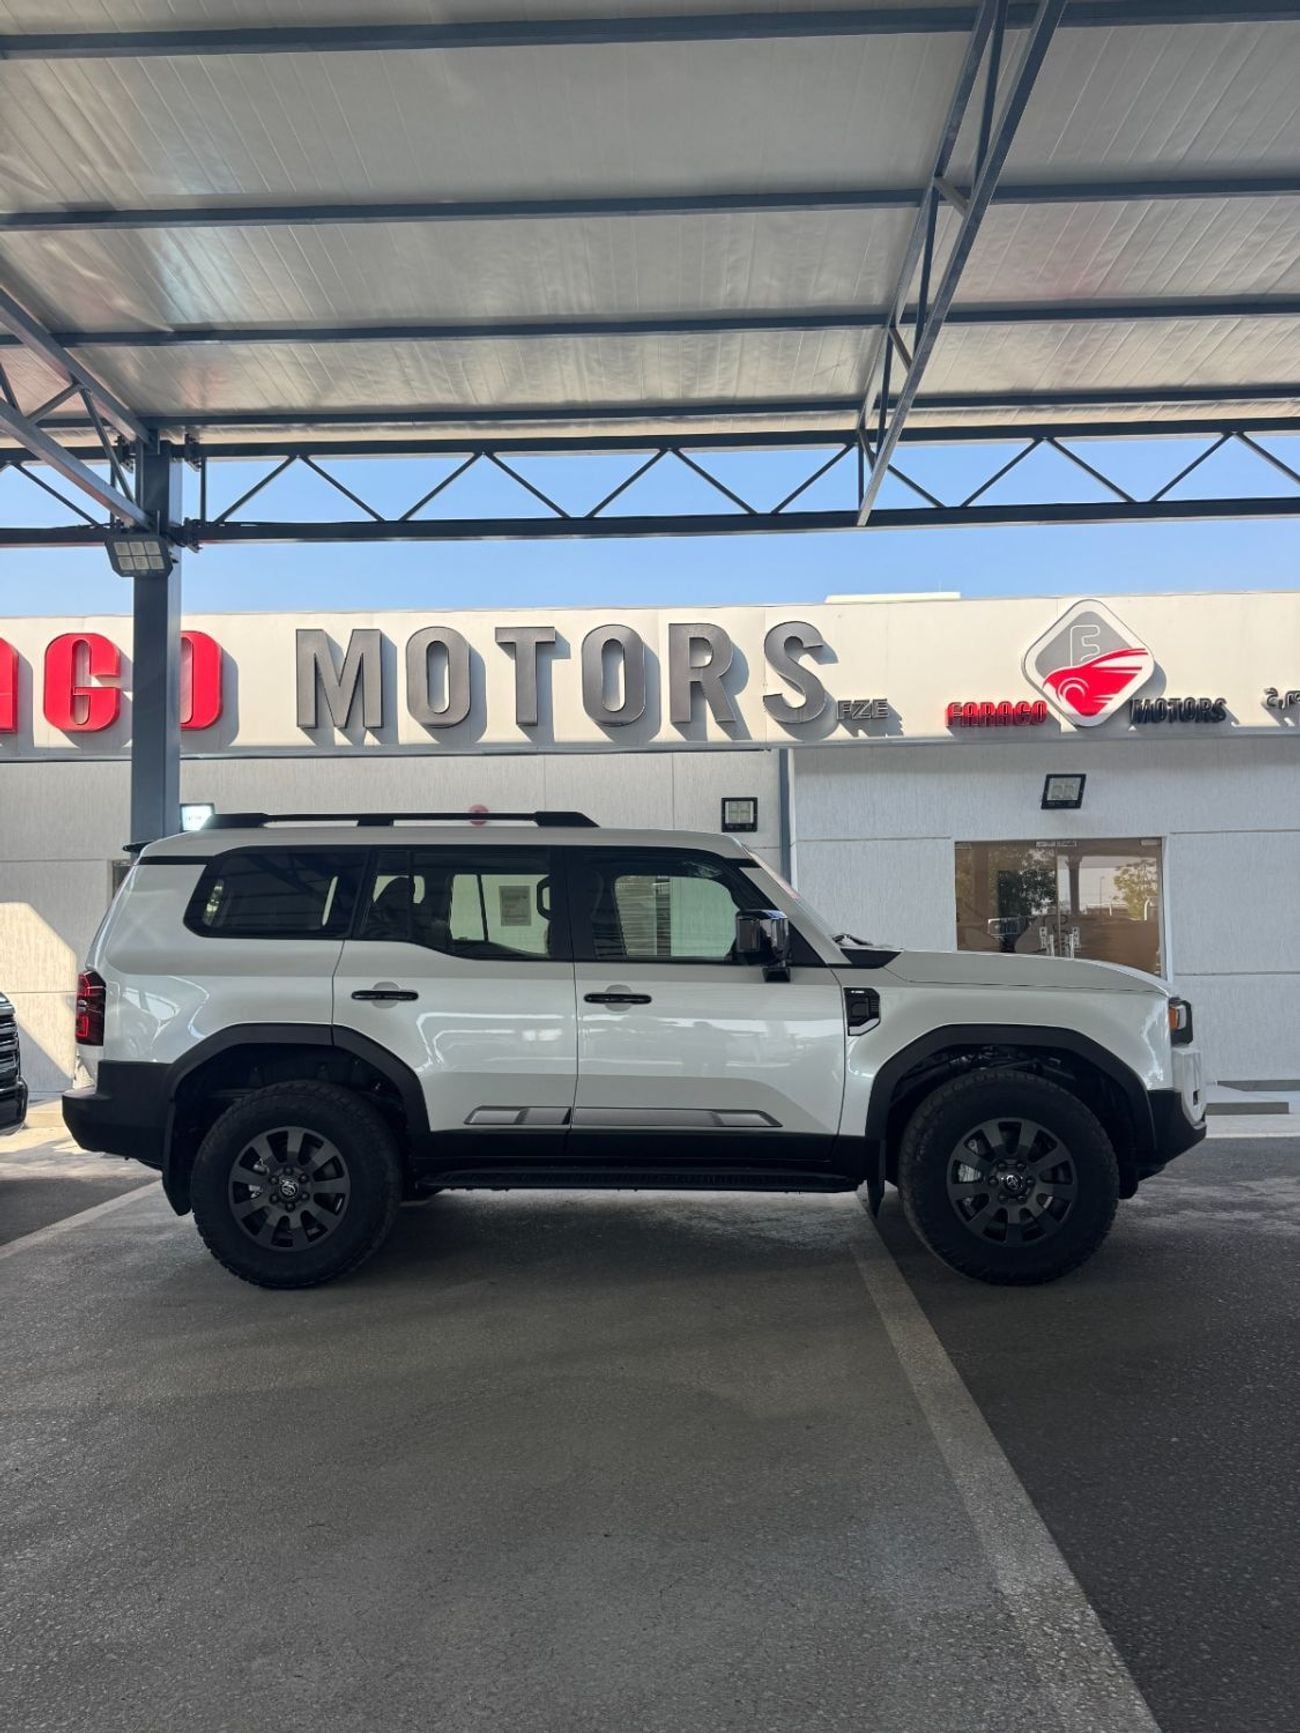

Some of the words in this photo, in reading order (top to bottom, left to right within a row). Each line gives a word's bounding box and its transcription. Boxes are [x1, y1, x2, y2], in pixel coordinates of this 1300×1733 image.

[0, 630, 223, 733] GO
[296, 620, 828, 728] MOTORS
[836, 698, 888, 720] FZE
[945, 700, 1047, 727] FARAGO
[1130, 697, 1227, 724] MOTORS
